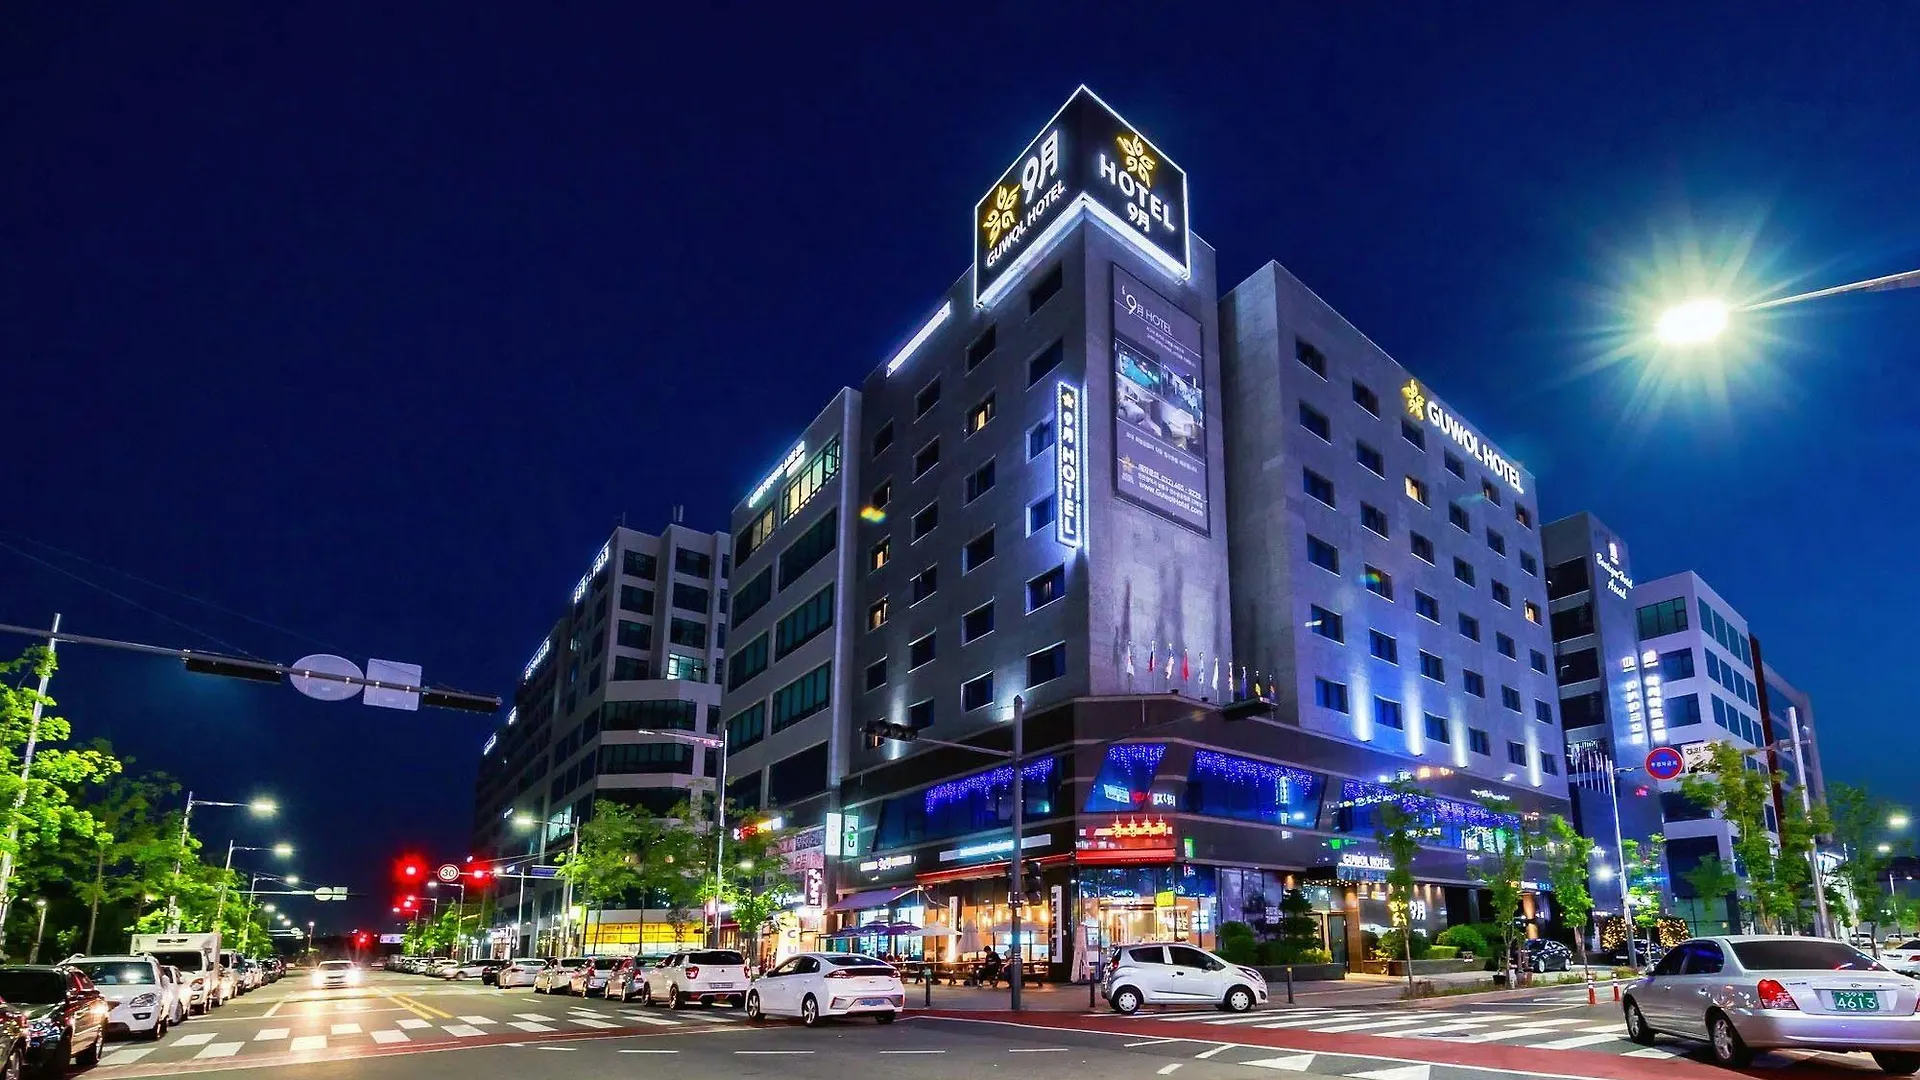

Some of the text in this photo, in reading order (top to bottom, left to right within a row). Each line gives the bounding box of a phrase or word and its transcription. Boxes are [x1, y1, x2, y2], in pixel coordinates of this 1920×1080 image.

[986, 180, 1066, 268] GUWOL HOTEL
[1100, 153, 1175, 232] HOTEL
[1145, 309, 1172, 336] HOTEL
[1427, 401, 1524, 494] GUWOL HOTEL
[1062, 446, 1076, 535] HOTEL
[442, 868, 455, 877] 30
[1837, 997, 1876, 1009] 4613
